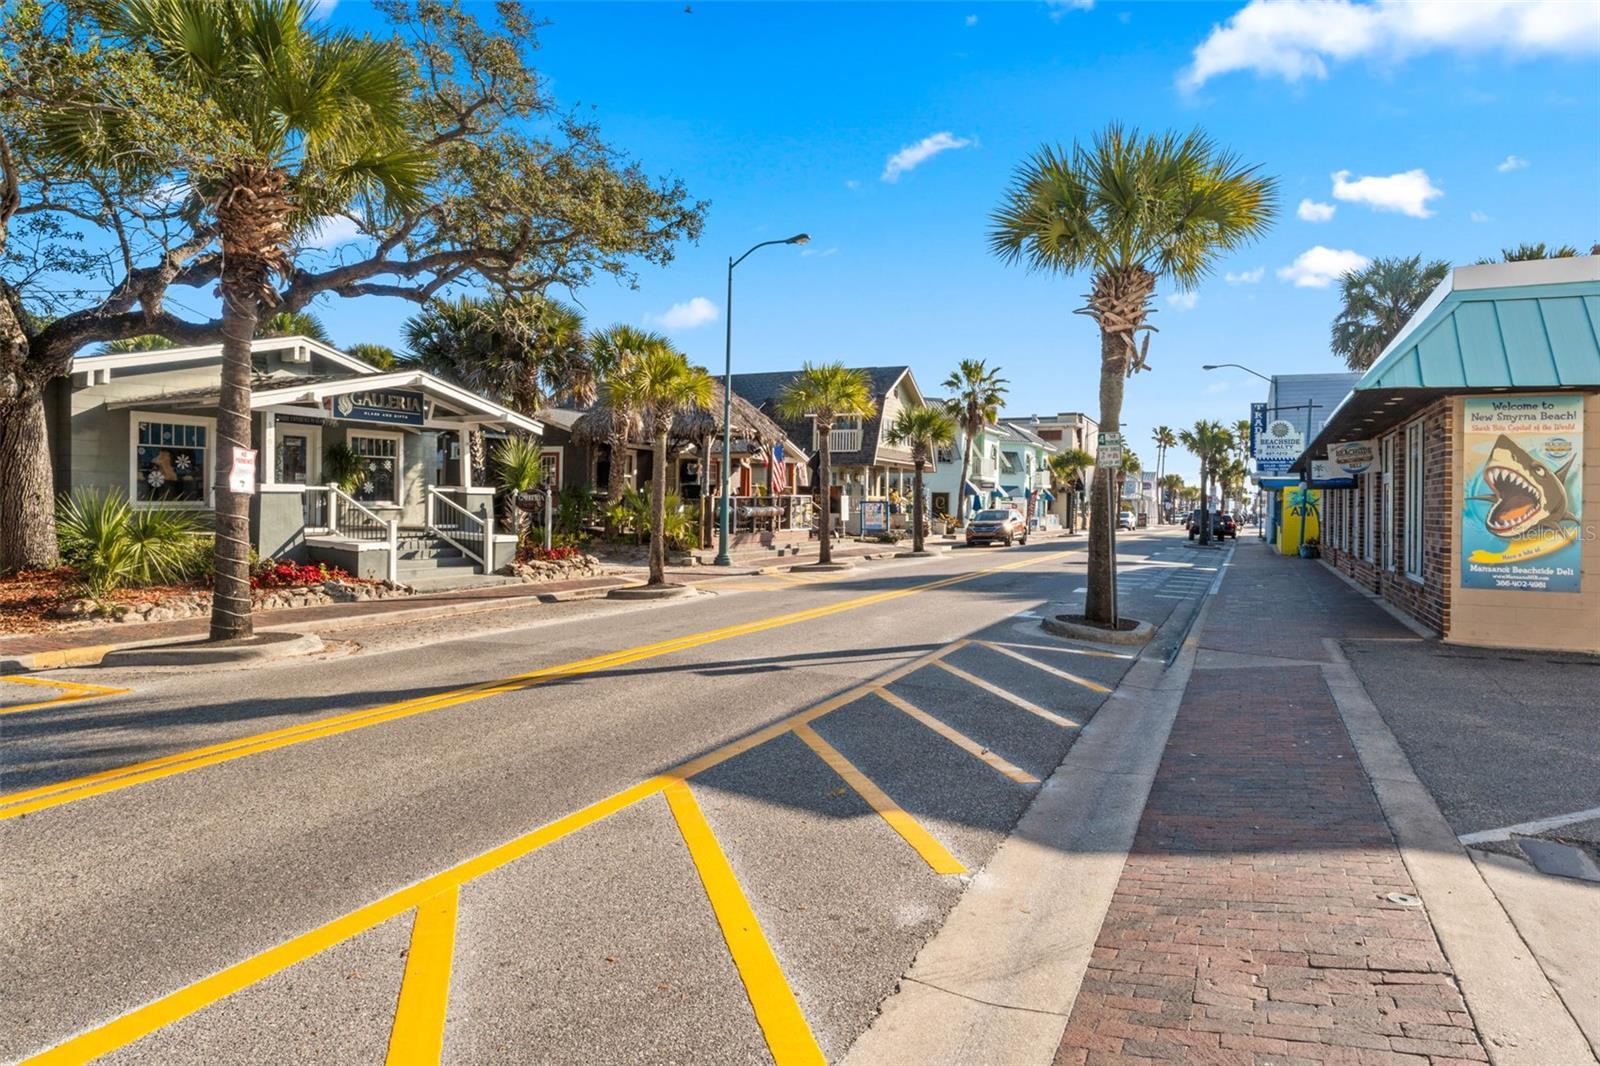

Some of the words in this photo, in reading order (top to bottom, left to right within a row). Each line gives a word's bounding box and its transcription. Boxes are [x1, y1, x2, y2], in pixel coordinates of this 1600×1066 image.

[350, 392, 420, 411] GALLERIA
[1492, 402, 1538, 411] Welcome
[1542, 401, 1555, 410] to
[1471, 412, 1494, 422] New
[1497, 411, 1537, 424] Smyrna
[1540, 410, 1577, 421] Beach!
[1512, 566, 1554, 576] Beachside
[1556, 567, 1574, 576] Deli
